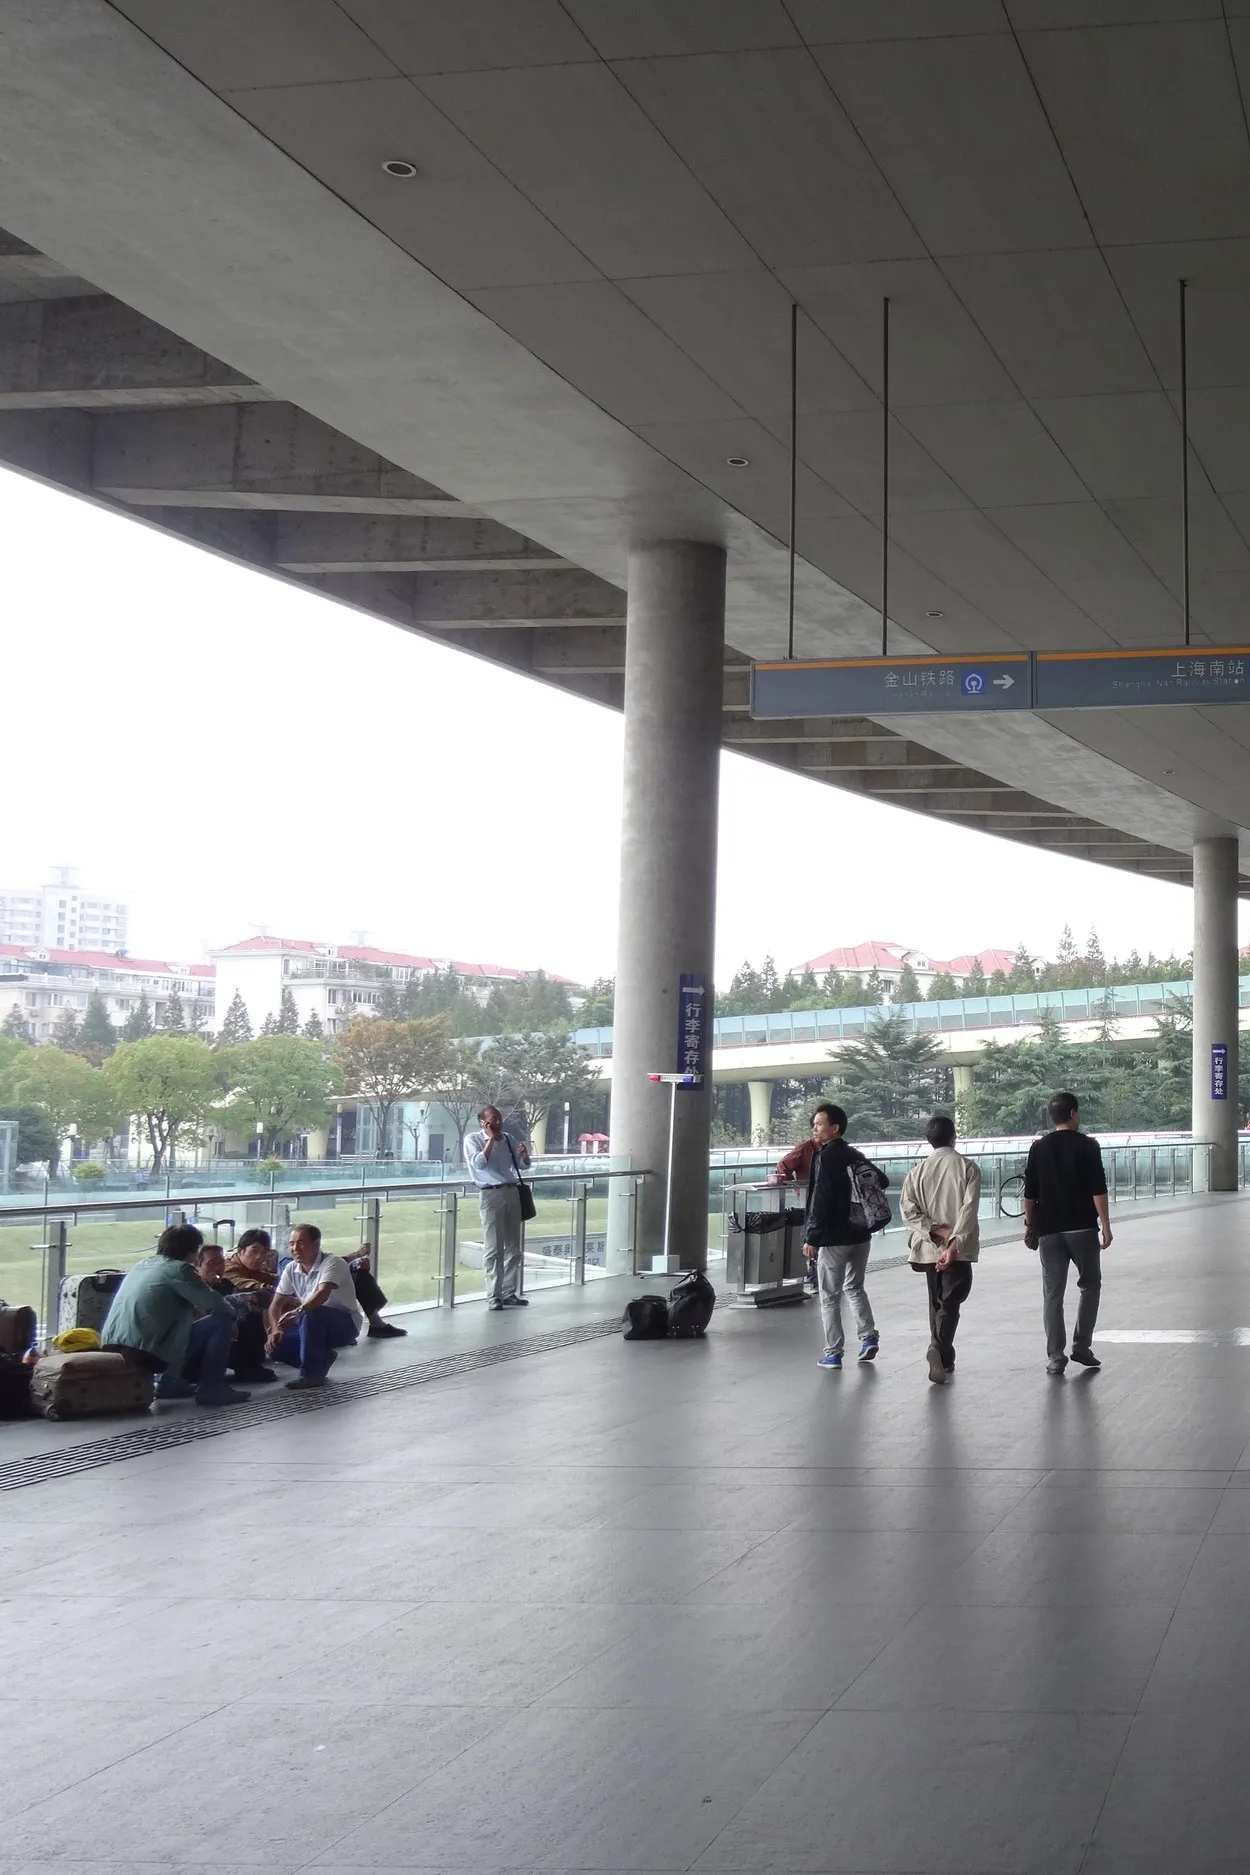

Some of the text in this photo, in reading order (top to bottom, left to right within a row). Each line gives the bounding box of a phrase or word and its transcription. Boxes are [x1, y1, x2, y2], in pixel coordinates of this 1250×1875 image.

[1171, 659, 1245, 678] 上海南站
[883, 669, 956, 688] 金山铁路
[1214, 1057, 1224, 1095] 行李寄存处
[542, 1241, 605, 1257] 盛泰奥莱斯
